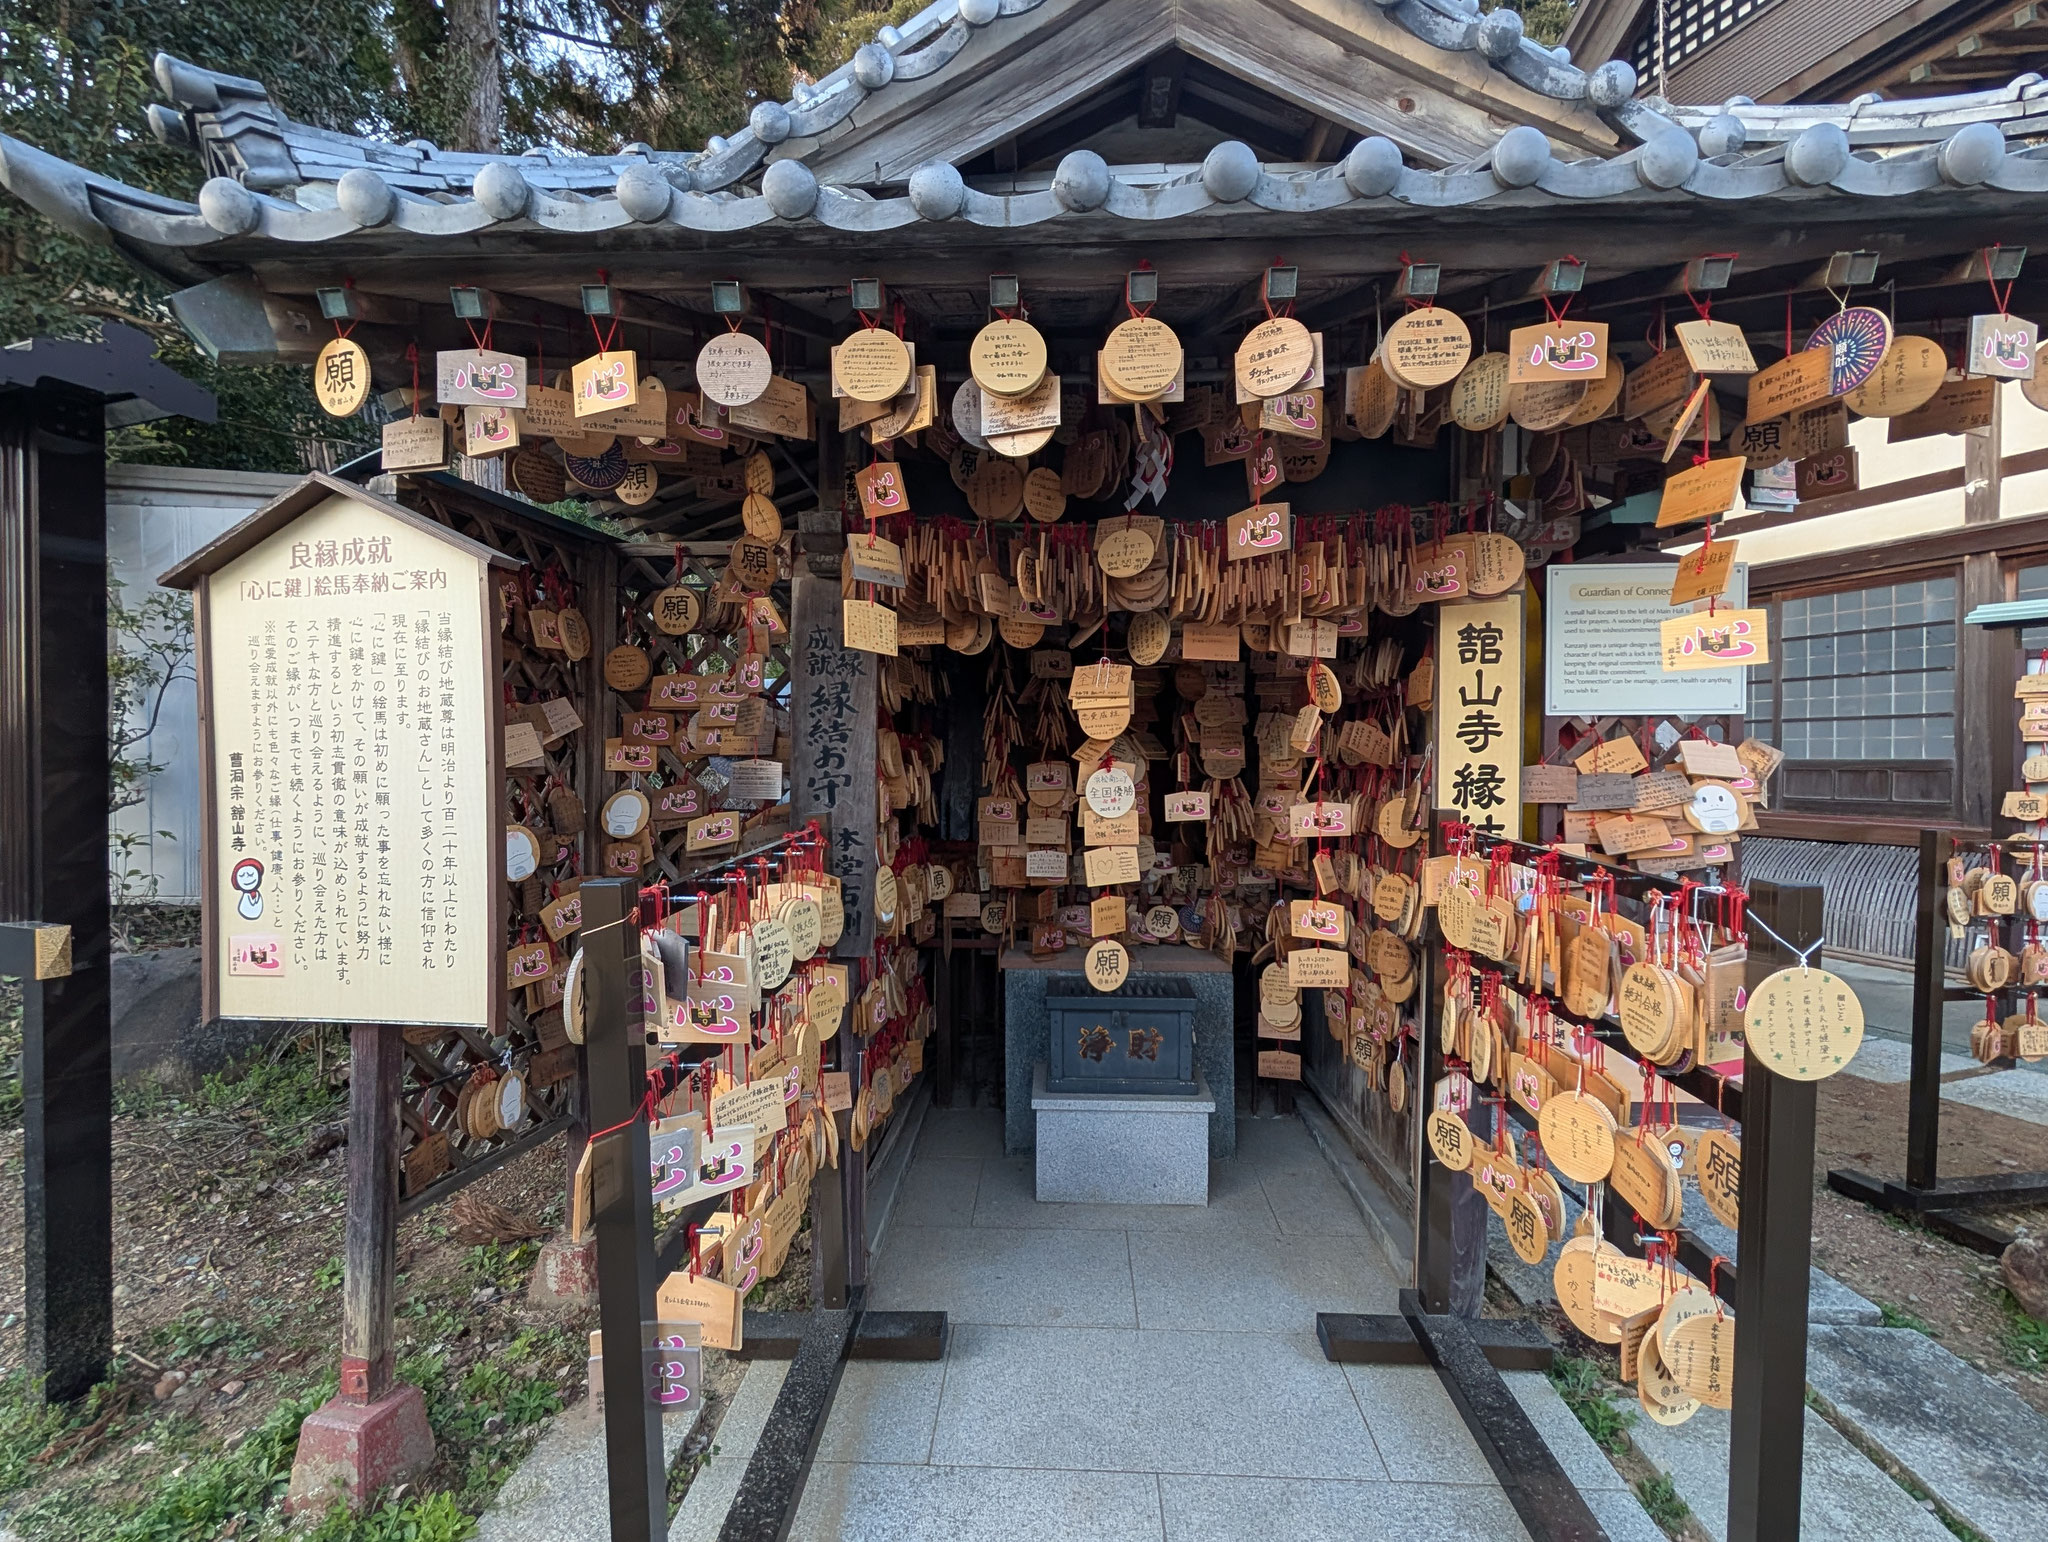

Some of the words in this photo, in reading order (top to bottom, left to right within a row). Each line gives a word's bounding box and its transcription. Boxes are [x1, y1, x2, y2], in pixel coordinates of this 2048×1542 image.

[325, 350, 356, 393] 願
[1741, 425, 1781, 451] 願
[290, 536, 392, 569] 良縁成就
[741, 544, 768, 575] 願
[240, 568, 447, 601] 「心に鍵」絵馬奉納ご案内
[661, 595, 690, 621] 願
[1579, 587, 1620, 597] Guardian
[1624, 587, 1634, 597] of
[1636, 587, 1673, 597] Connec
[392, 613, 411, 729] 現在に至ります。
[806, 624, 834, 677] 成就
[1311, 672, 1333, 699] 願
[248, 635, 267, 852] 巡り会えますようにお参りください。
[229, 752, 245, 801] 曹洞宗
[286, 620, 308, 971] そのご縁がいつまでも続くようにお参りください。
[307, 619, 328, 961] ステキな方と巡り会えるように、巡り会えた方は
[349, 616, 371, 961] 心に鍵をかけて、その願いが成就するように努力
[371, 612, 393, 966] 「心に鍵」の絵馬は初めに願った事を忘れない様に
[415, 609, 436, 969] 「縁結びのお地蔵さん」として多くの方に信仰され
[437, 611, 459, 968] 当縁結び地蔵尊は明治より百二十年以上にわたり
[327, 617, 350, 985] 精進するという初志貫徹の意味が込められています。
[2017, 800, 2040, 813] 願
[230, 804, 247, 852] 舘山寺
[1992, 882, 2011, 901] 願
[1151, 909, 1172, 929] 願
[1094, 949, 1120, 976] 願
[1435, 1118, 1462, 1156] 願
[1706, 1141, 1740, 1208] 願
[1511, 1196, 1536, 1248] 願
